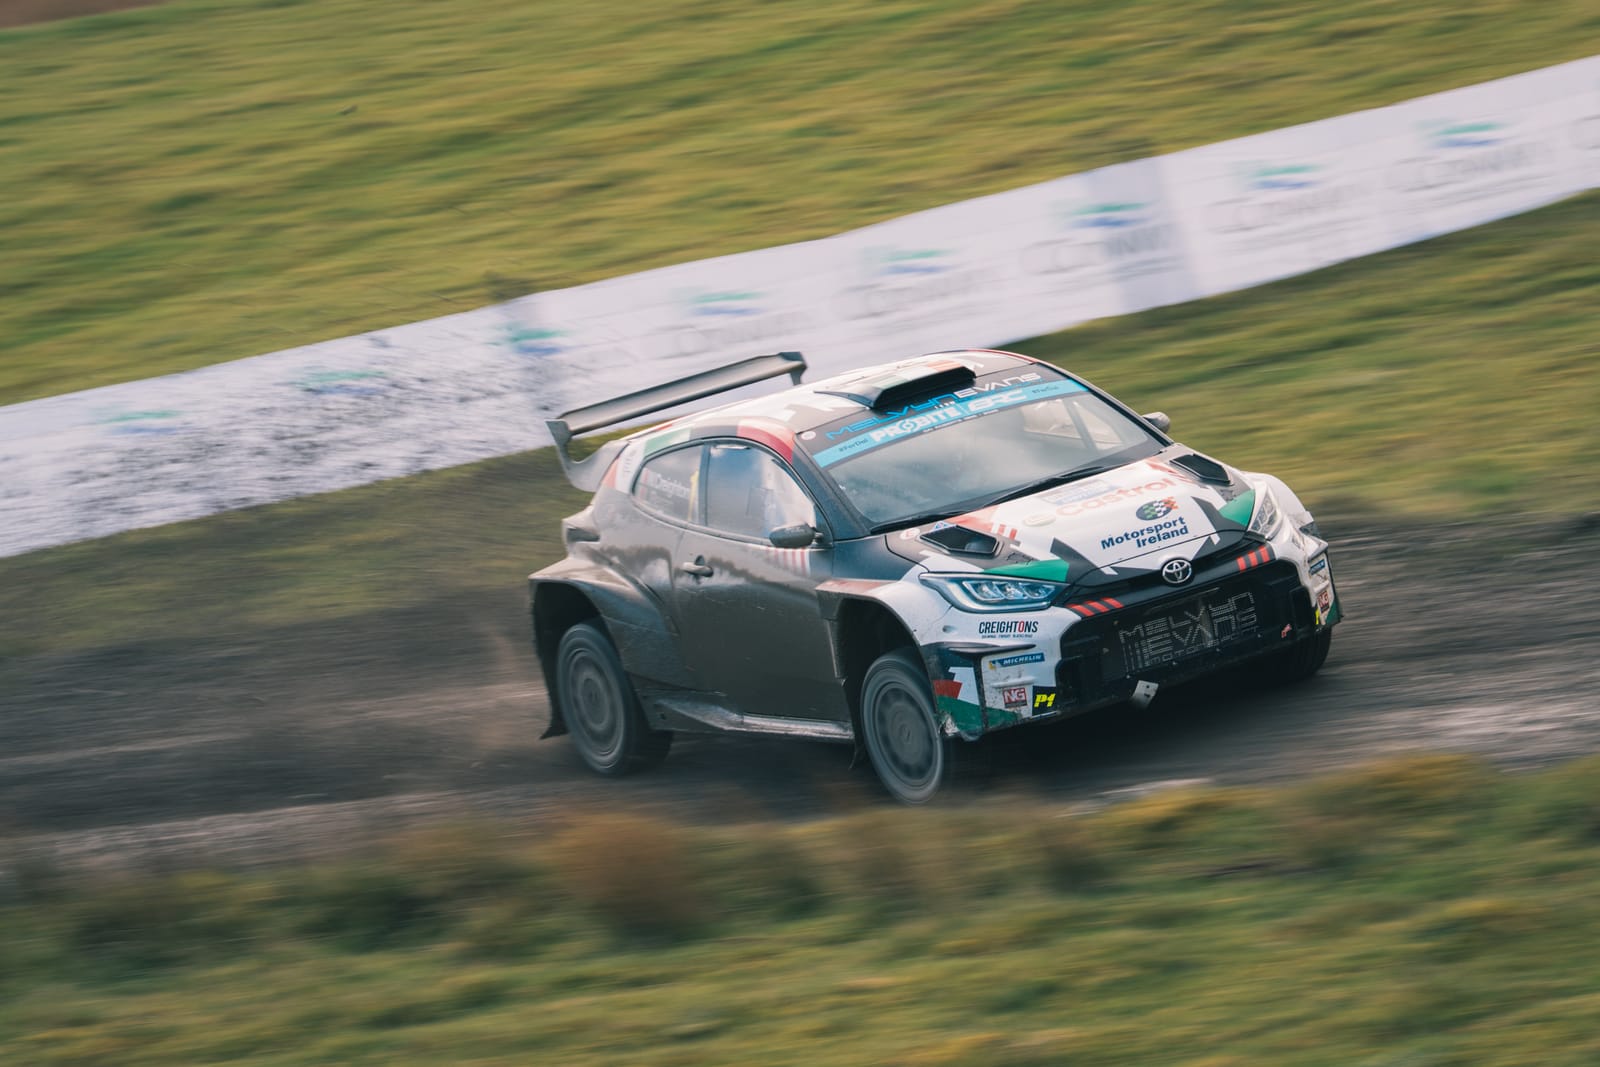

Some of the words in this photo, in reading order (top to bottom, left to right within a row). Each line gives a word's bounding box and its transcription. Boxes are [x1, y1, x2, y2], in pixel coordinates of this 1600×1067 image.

[1056, 478, 1176, 516] Castrol
[1101, 516, 1186, 550] Motorsport
[1136, 525, 1189, 548] Ireland
[979, 621, 1039, 634] CREIGHTONS
[1003, 654, 1042, 665] MICHELIN
[1004, 688, 1027, 703] NG
[1034, 693, 1056, 708] P1
